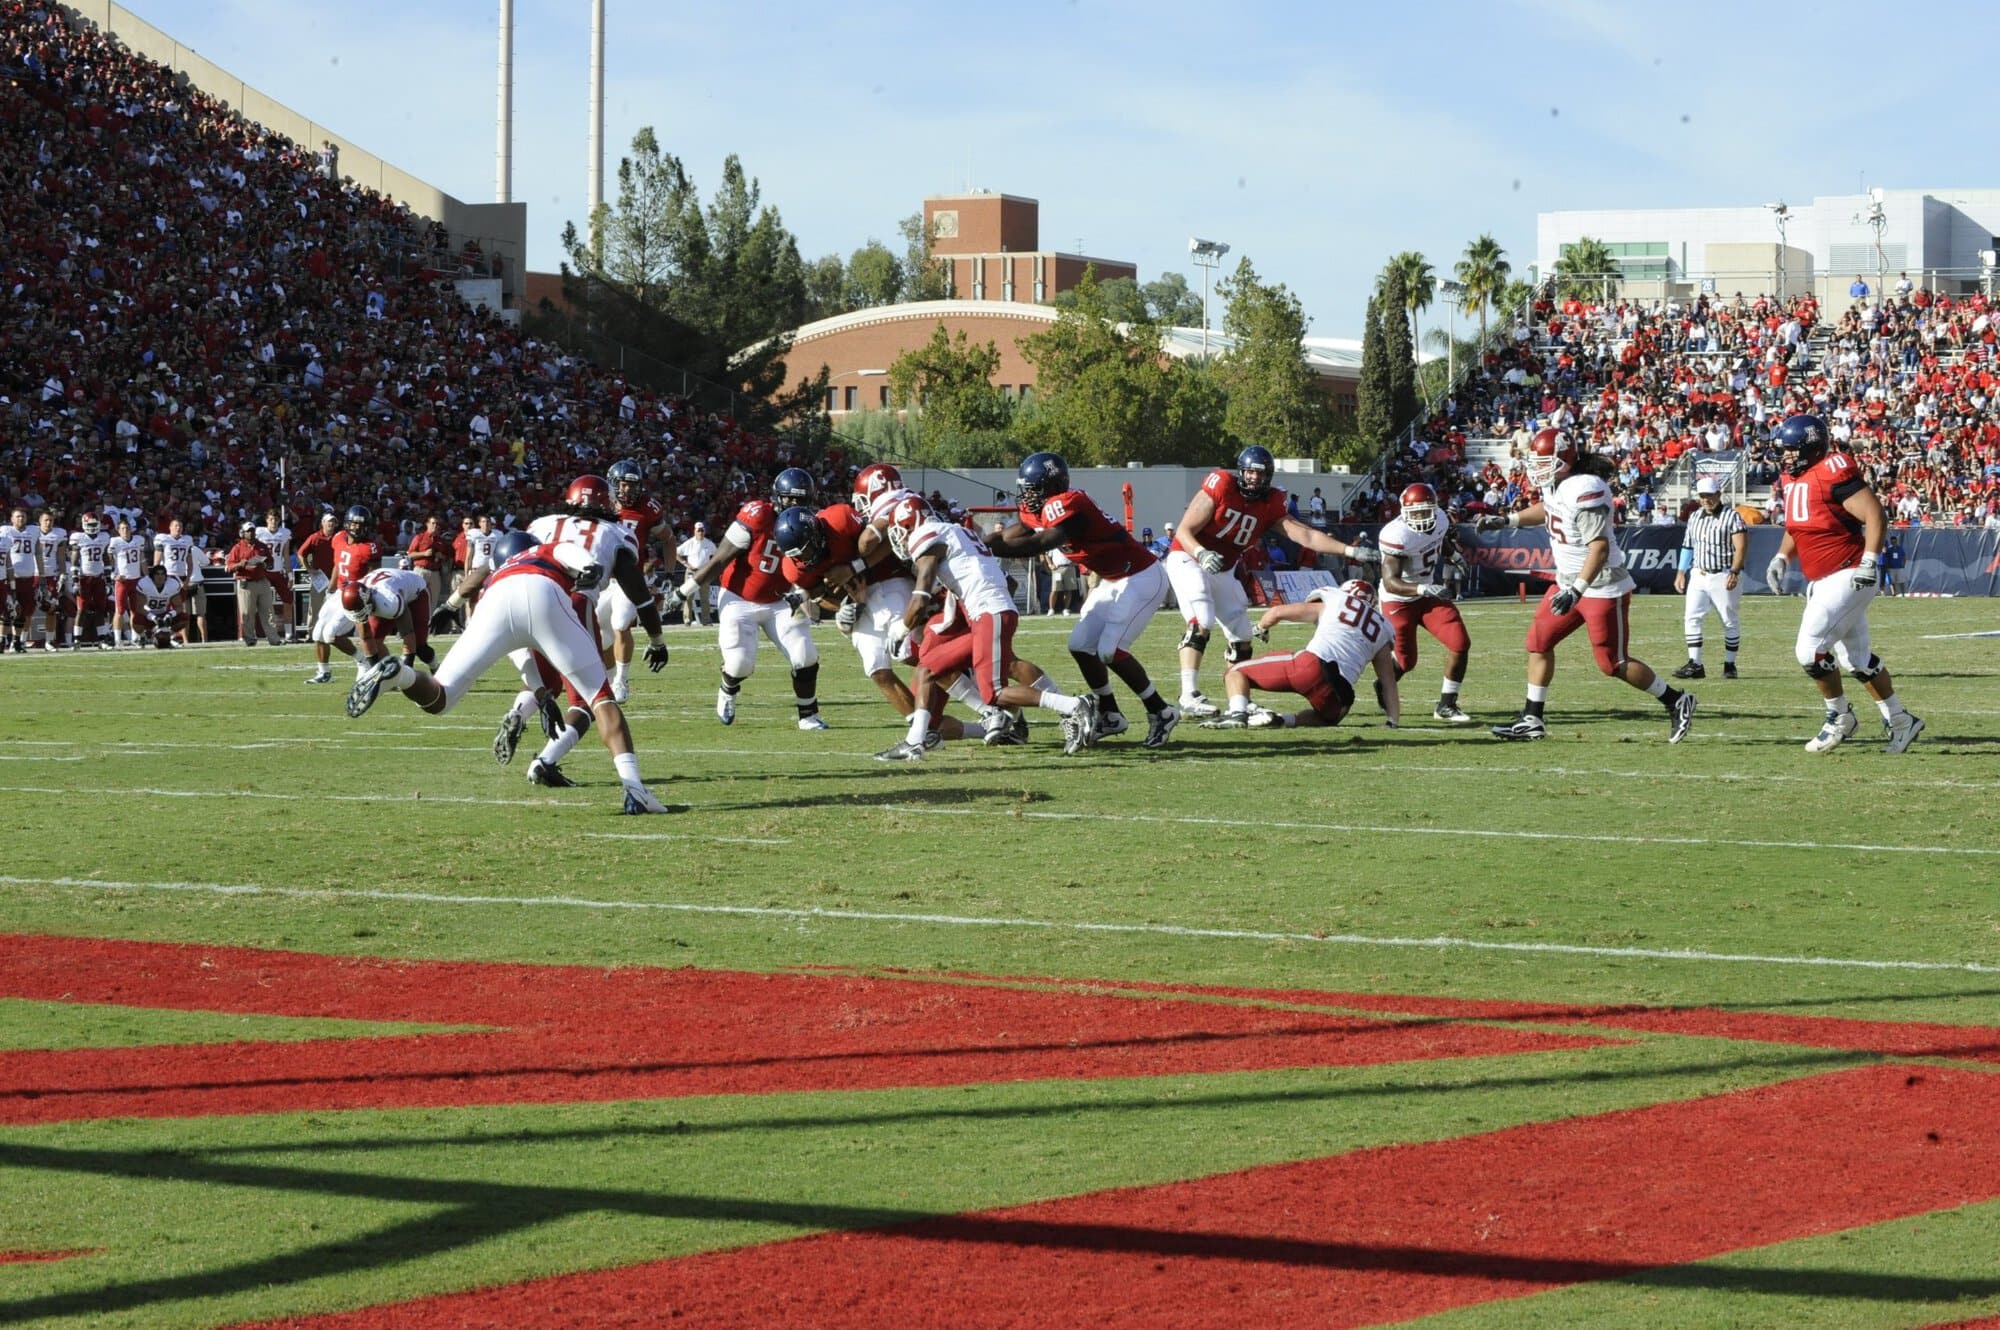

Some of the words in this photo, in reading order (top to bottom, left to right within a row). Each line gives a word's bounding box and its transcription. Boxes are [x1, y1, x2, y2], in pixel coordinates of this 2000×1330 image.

[1702, 280, 1713, 291] 26
[1824, 455, 1848, 473] 70
[1783, 481, 1809, 522] 70
[1215, 508, 1258, 546] 78
[14, 539, 32, 554] 78
[88, 547, 101, 562] 12
[170, 547, 187, 562] 37
[126, 549, 139, 564] 13
[338, 550, 352, 577] 2
[758, 539, 781, 574] 5
[1338, 594, 1385, 643] 96
